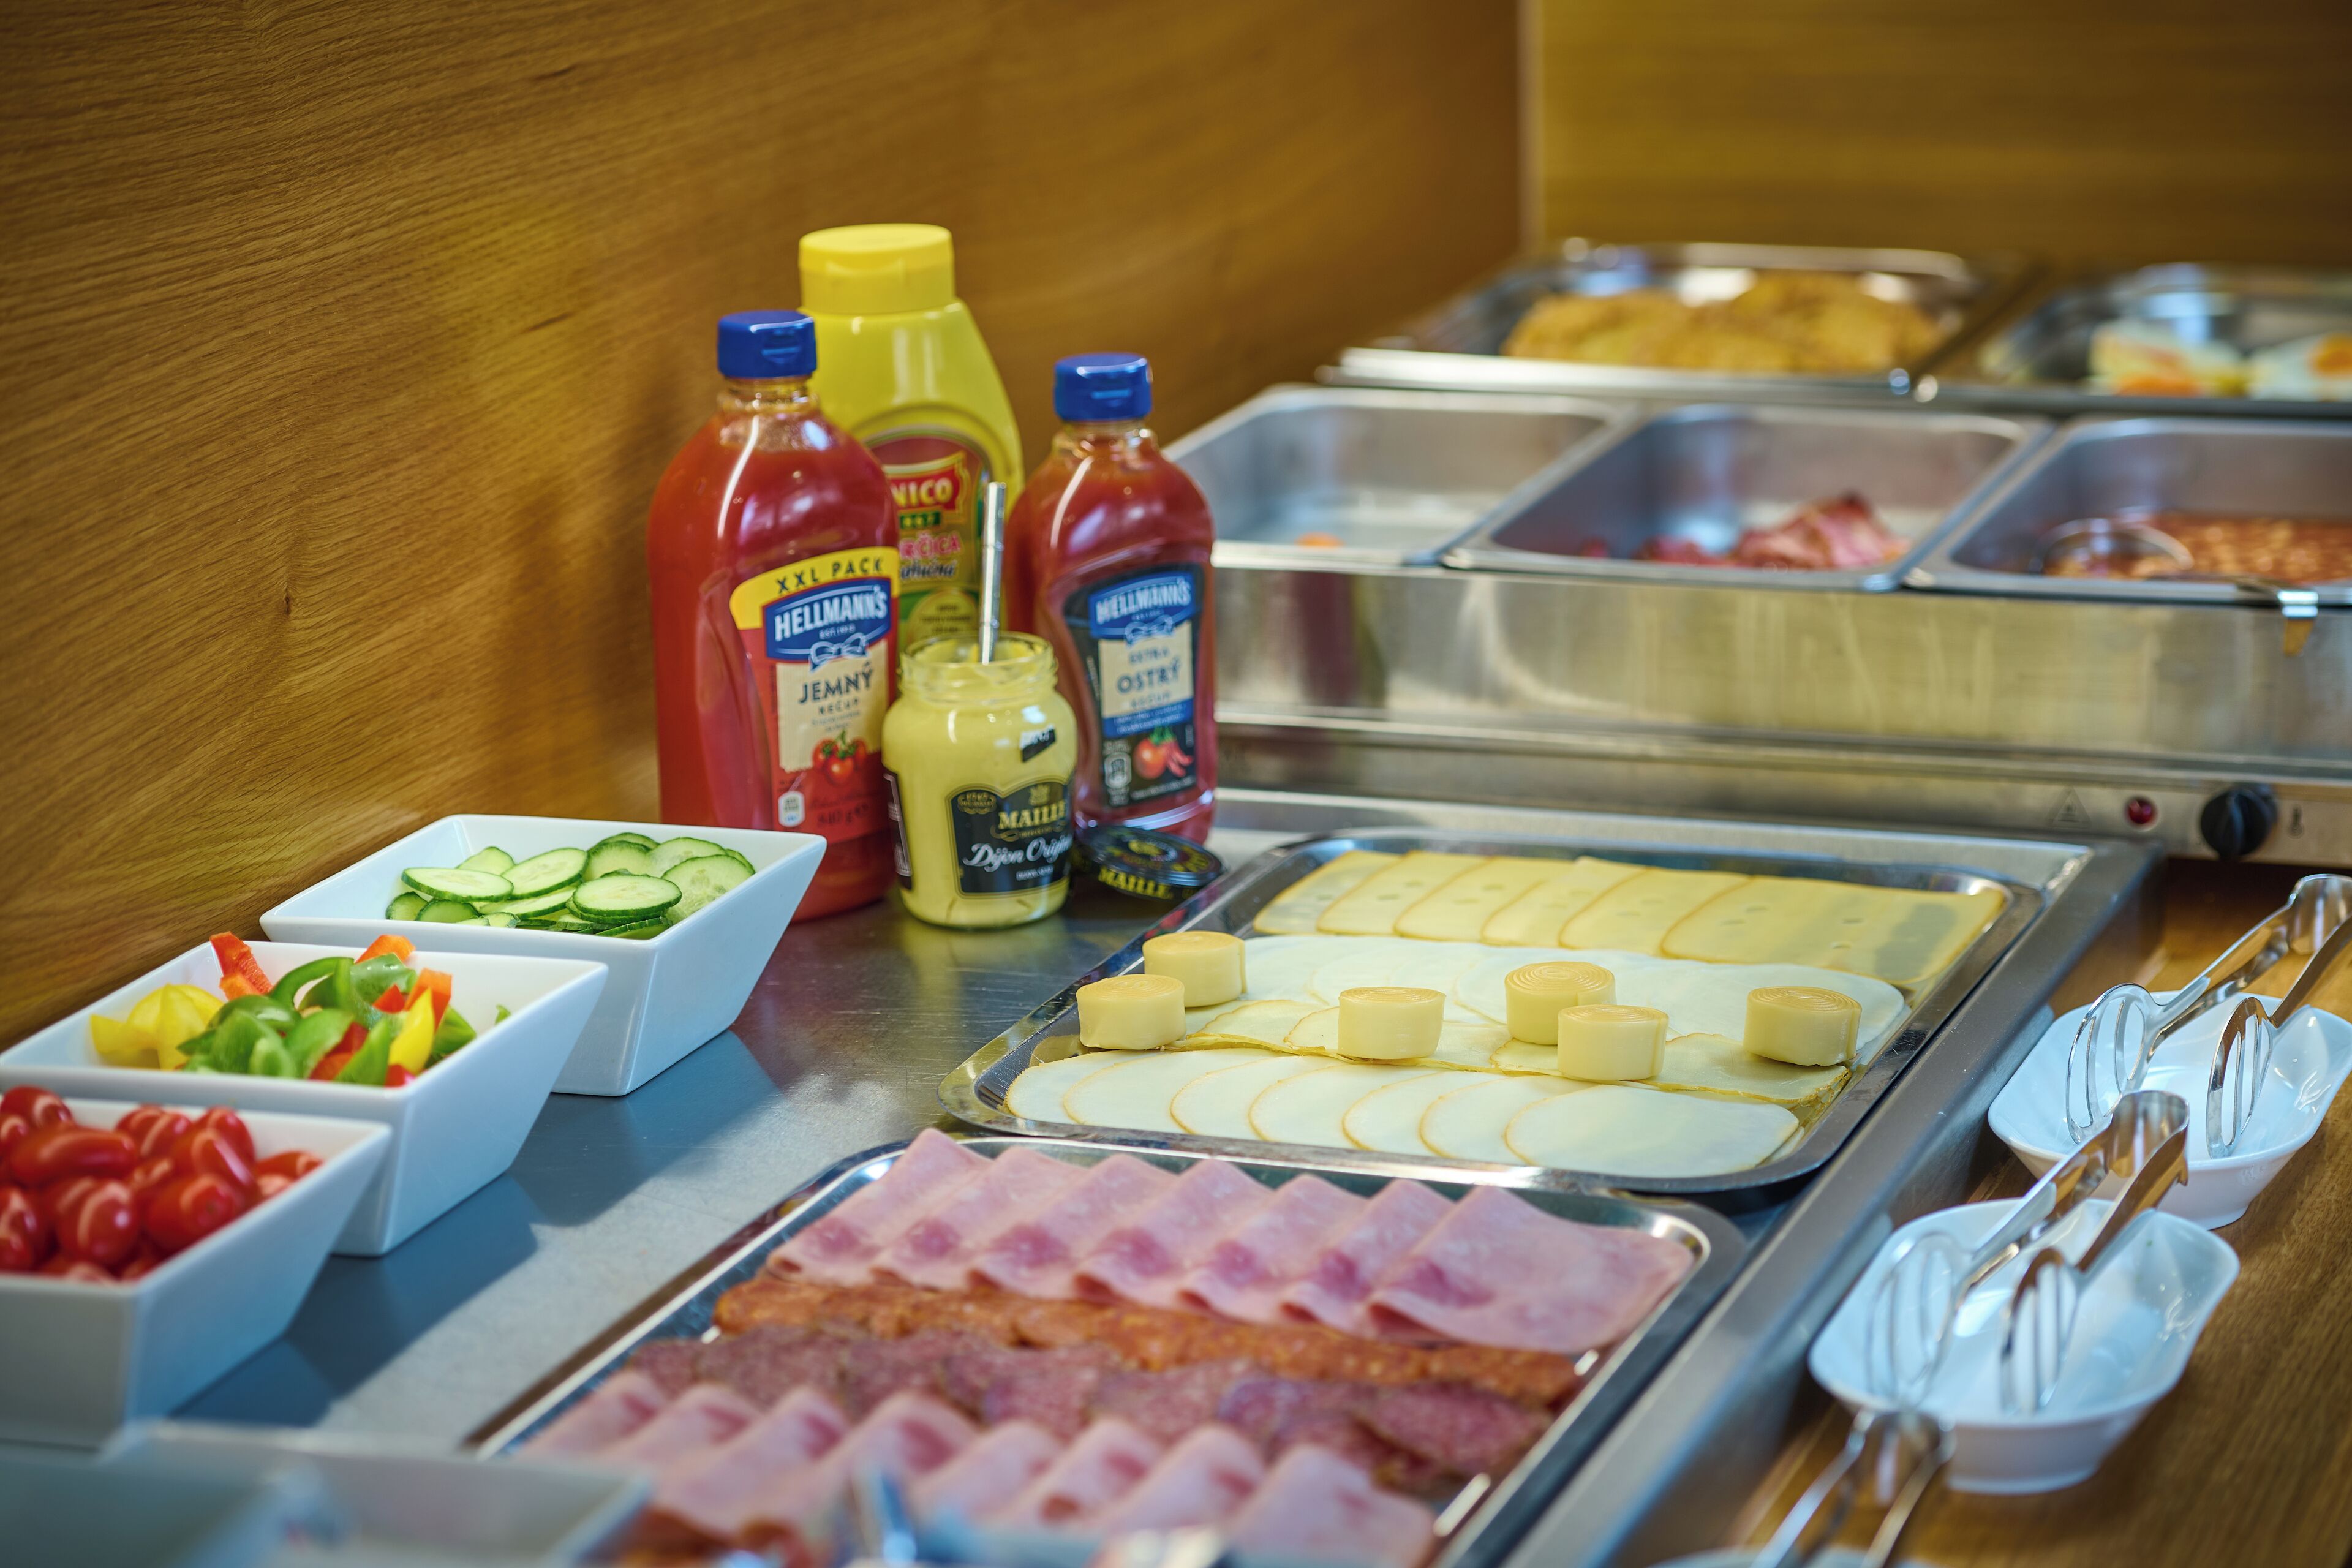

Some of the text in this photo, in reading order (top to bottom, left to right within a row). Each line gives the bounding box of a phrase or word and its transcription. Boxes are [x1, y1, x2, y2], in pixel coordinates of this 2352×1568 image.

[776, 557, 883, 594] XXL PACK
[774, 584, 888, 642] HELLMANN'S
[799, 661, 873, 704] JEMNÝ
[1116, 655, 1182, 694] OSTRÝ
[962, 843, 1025, 872] Dijon
[1098, 866, 1173, 900] MAILLE
